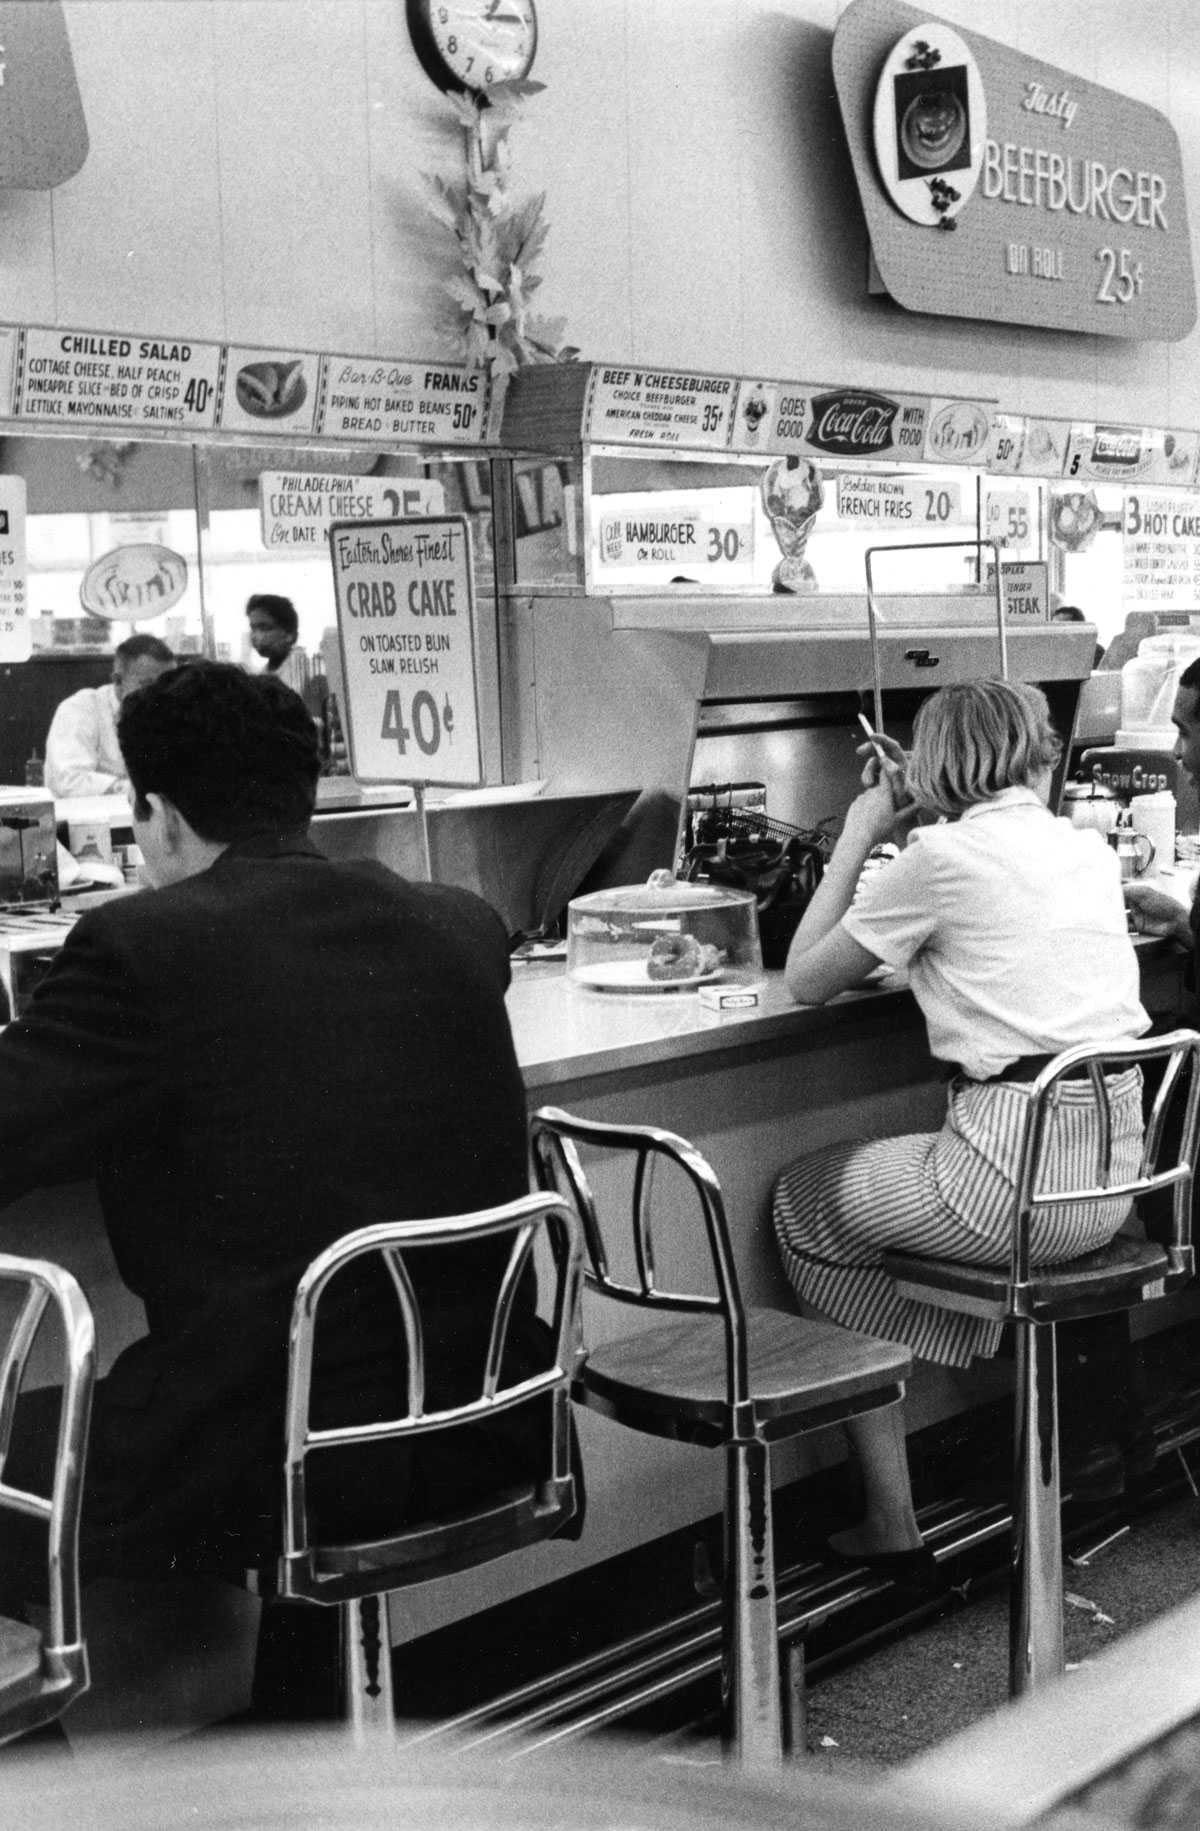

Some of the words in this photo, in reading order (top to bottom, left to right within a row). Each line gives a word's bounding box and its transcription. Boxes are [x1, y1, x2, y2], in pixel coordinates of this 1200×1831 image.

[447, 35, 458, 55] 8
[466, 57, 475, 73] 7
[485, 66, 493, 84] 6
[1024, 82, 1078, 129] Tasty
[983, 139, 1168, 231] BEEFBURGER
[1096, 248, 1143, 303] 25¢
[60, 335, 132, 357] CHILLED
[139, 342, 192, 362] SALAD
[28, 358, 70, 376] COTTAGE
[117, 365, 143, 380] HALF
[28, 378, 73, 394] PINEAPPLE
[78, 380, 101, 396] SLICE
[131, 384, 143, 398] OF
[147, 384, 180, 400] CRISP
[424, 372, 479, 392] FRANKS
[602, 370, 632, 385] BEEF
[645, 374, 730, 394] CHEESEBURGER
[184, 378, 214, 413] 40¢
[331, 395, 360, 411] PIPING
[364, 397, 382, 411] HOT
[384, 398, 414, 414] BAKED
[419, 401, 451, 416] BEANS
[780, 397, 806, 415] GOES
[67, 401, 134, 418] MAYONNAISE
[142, 405, 185, 421] SALTINES
[452, 403, 477, 429] 50¢
[903, 407, 925, 424] WITH
[342, 417, 382, 431] BREAD
[392, 420, 435, 434] BUTTER
[776, 420, 804, 438] GOOD
[818, 403, 893, 445] Coca-Cola
[900, 427, 922, 446] FOOD
[270, 495, 323, 518] CREAM
[328, 496, 374, 518] CHEESE
[841, 496, 880, 517] FRENCH
[884, 500, 912, 519] FRIES
[1127, 497, 1142, 535] 3
[1144, 514, 1167, 535] HOT
[292, 526, 317, 544] DATE
[625, 522, 696, 545] HAMBURGER
[338, 536, 381, 571] Eastern
[414, 528, 461, 568] Finest
[651, 548, 676, 561] ROLL
[346, 581, 397, 618] CRAB
[407, 579, 457, 617] CAKE
[360, 635, 374, 651] ON
[376, 634, 422, 651] TOASTED
[425, 634, 450, 651] BUN
[401, 657, 439, 674] RELISH
[380, 689, 454, 756] 40¢
